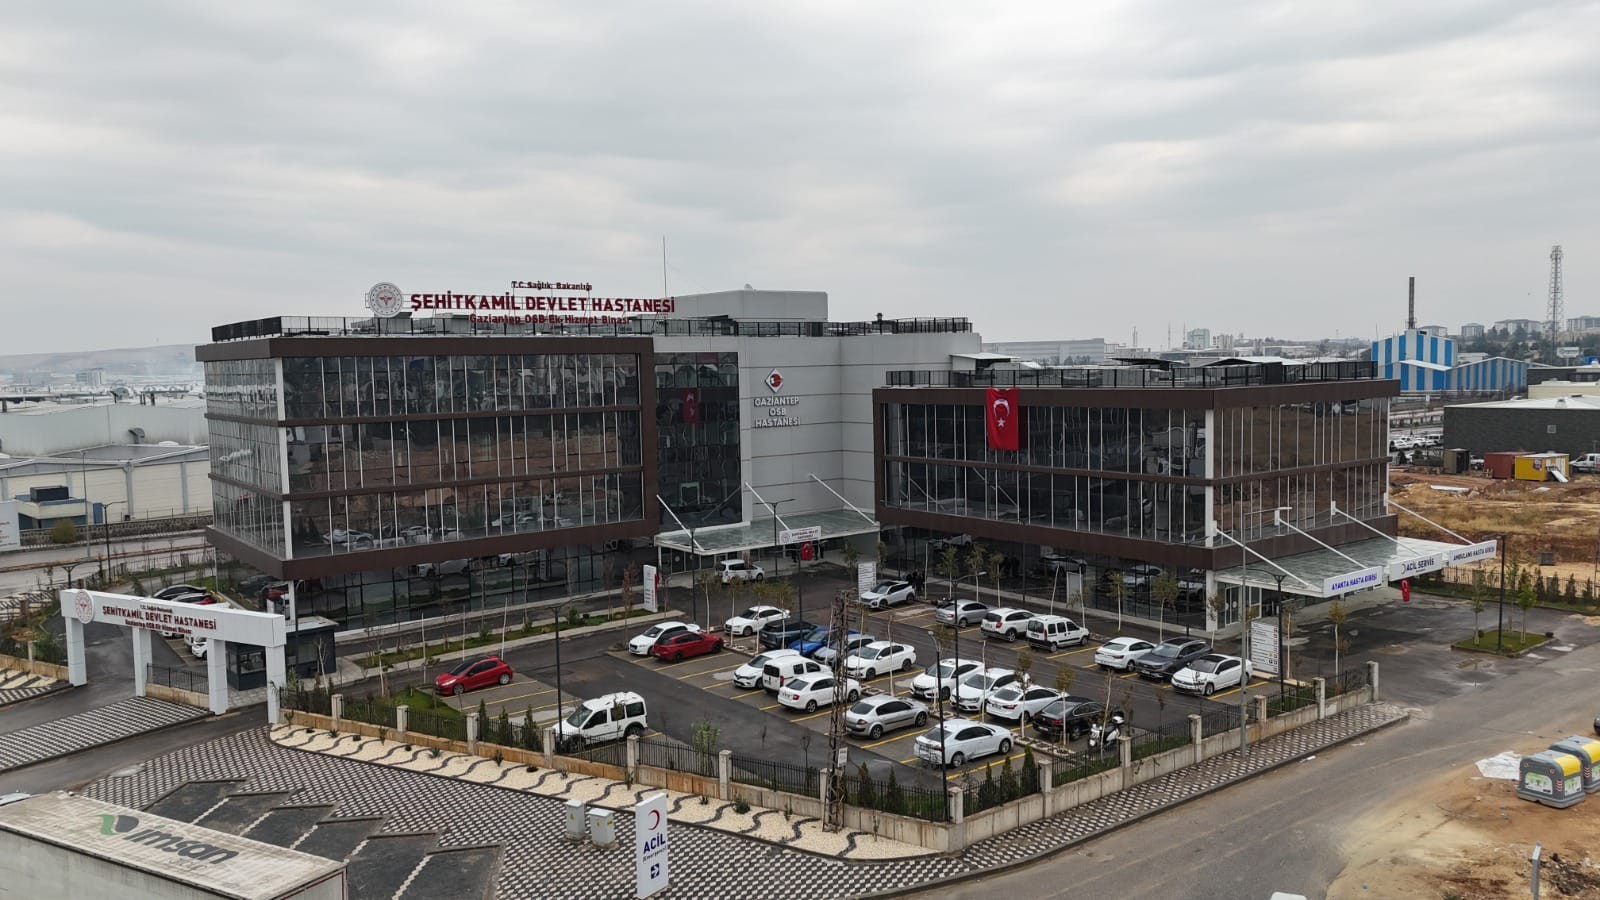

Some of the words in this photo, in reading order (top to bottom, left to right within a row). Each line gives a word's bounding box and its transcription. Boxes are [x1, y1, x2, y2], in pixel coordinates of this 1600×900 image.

[528, 281, 551, 290] Sağlık
[556, 283, 592, 291] Bakanlığı
[411, 290, 520, 311] ŞEHİTKAMİL
[526, 296, 588, 311] DEVLET
[592, 297, 675, 313] HASTANESİ
[769, 407, 787, 417] OSB
[755, 416, 801, 428] HASTANESİ
[145, 612, 172, 624] DEVLET
[174, 615, 217, 630] HASTANESİ
[643, 832, 666, 855] ACİL
